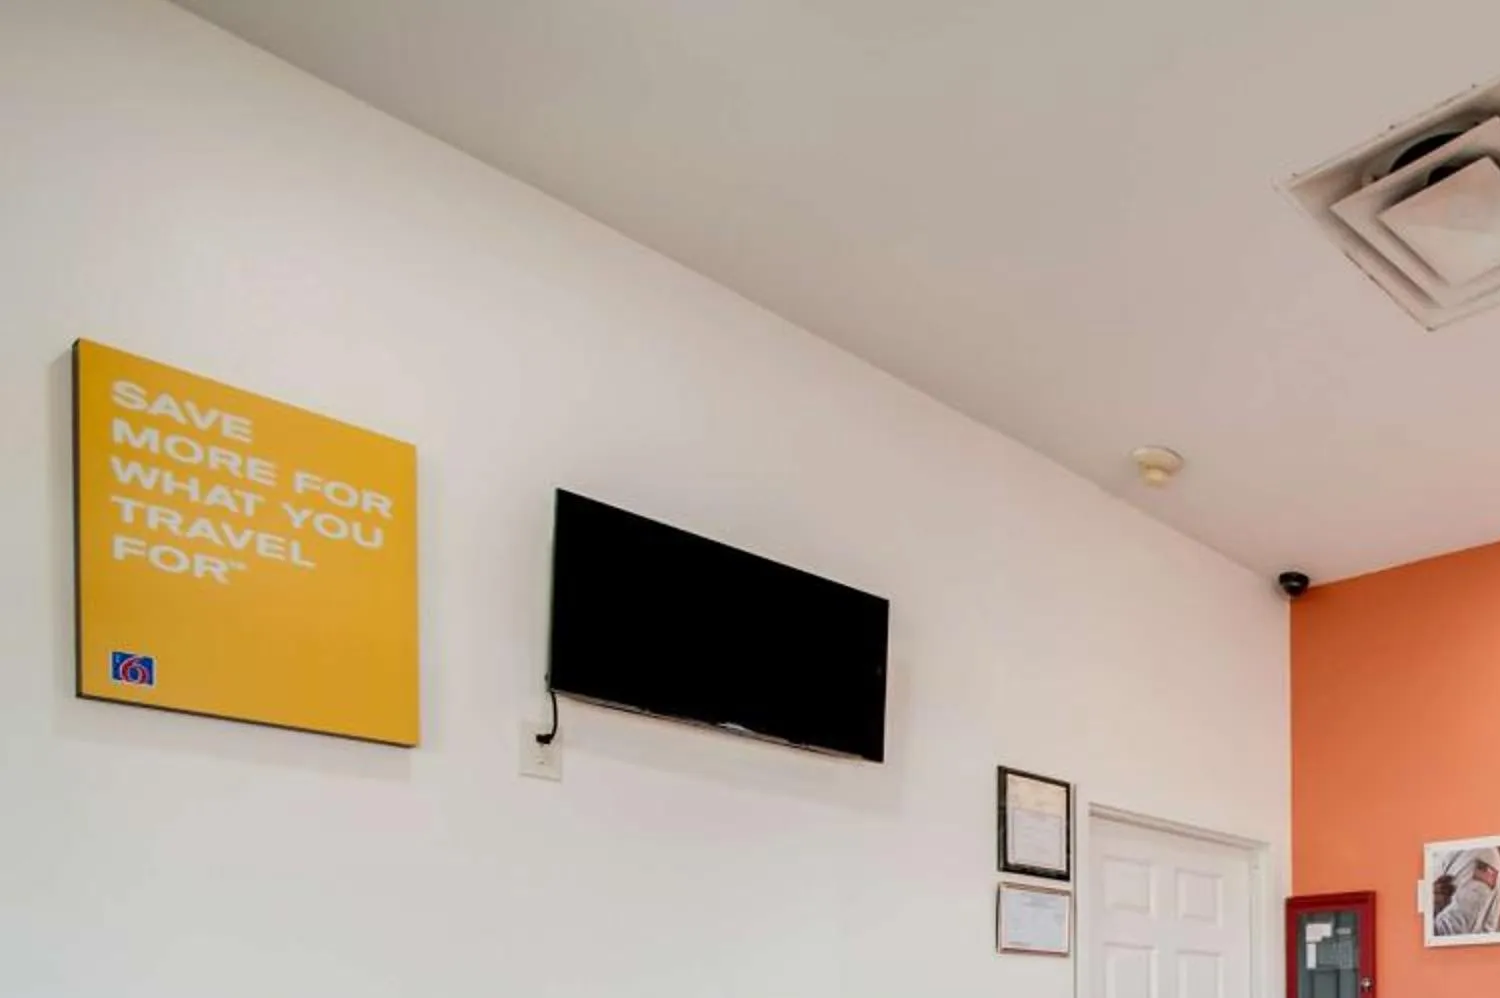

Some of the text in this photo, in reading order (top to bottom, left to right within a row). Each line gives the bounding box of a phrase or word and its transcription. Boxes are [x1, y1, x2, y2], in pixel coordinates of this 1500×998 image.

[112, 380, 253, 443] SAVE
[110, 456, 384, 549] WHAT YOU
[111, 418, 394, 519] MORE FOR
[111, 495, 316, 568] TRAVEL
